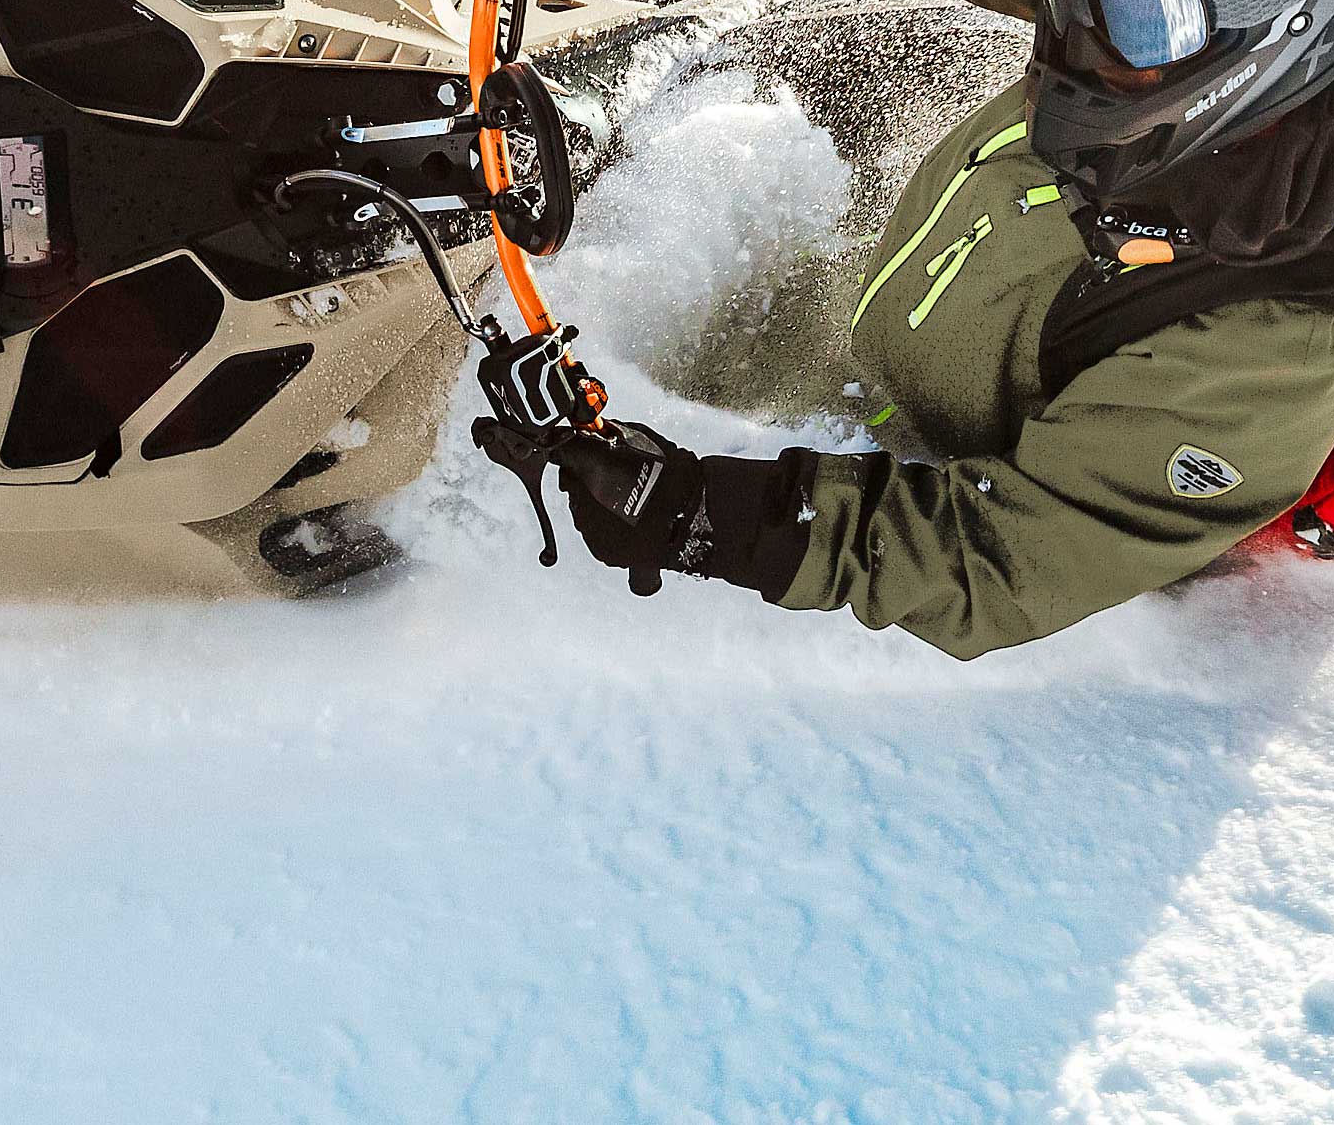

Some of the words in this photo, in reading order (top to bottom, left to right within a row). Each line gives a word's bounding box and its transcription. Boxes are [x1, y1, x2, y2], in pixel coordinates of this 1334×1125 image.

[1184, 62, 1258, 123] ski-doo
[1127, 221, 1168, 237] bca
[623, 461, 649, 516] ski-doo
